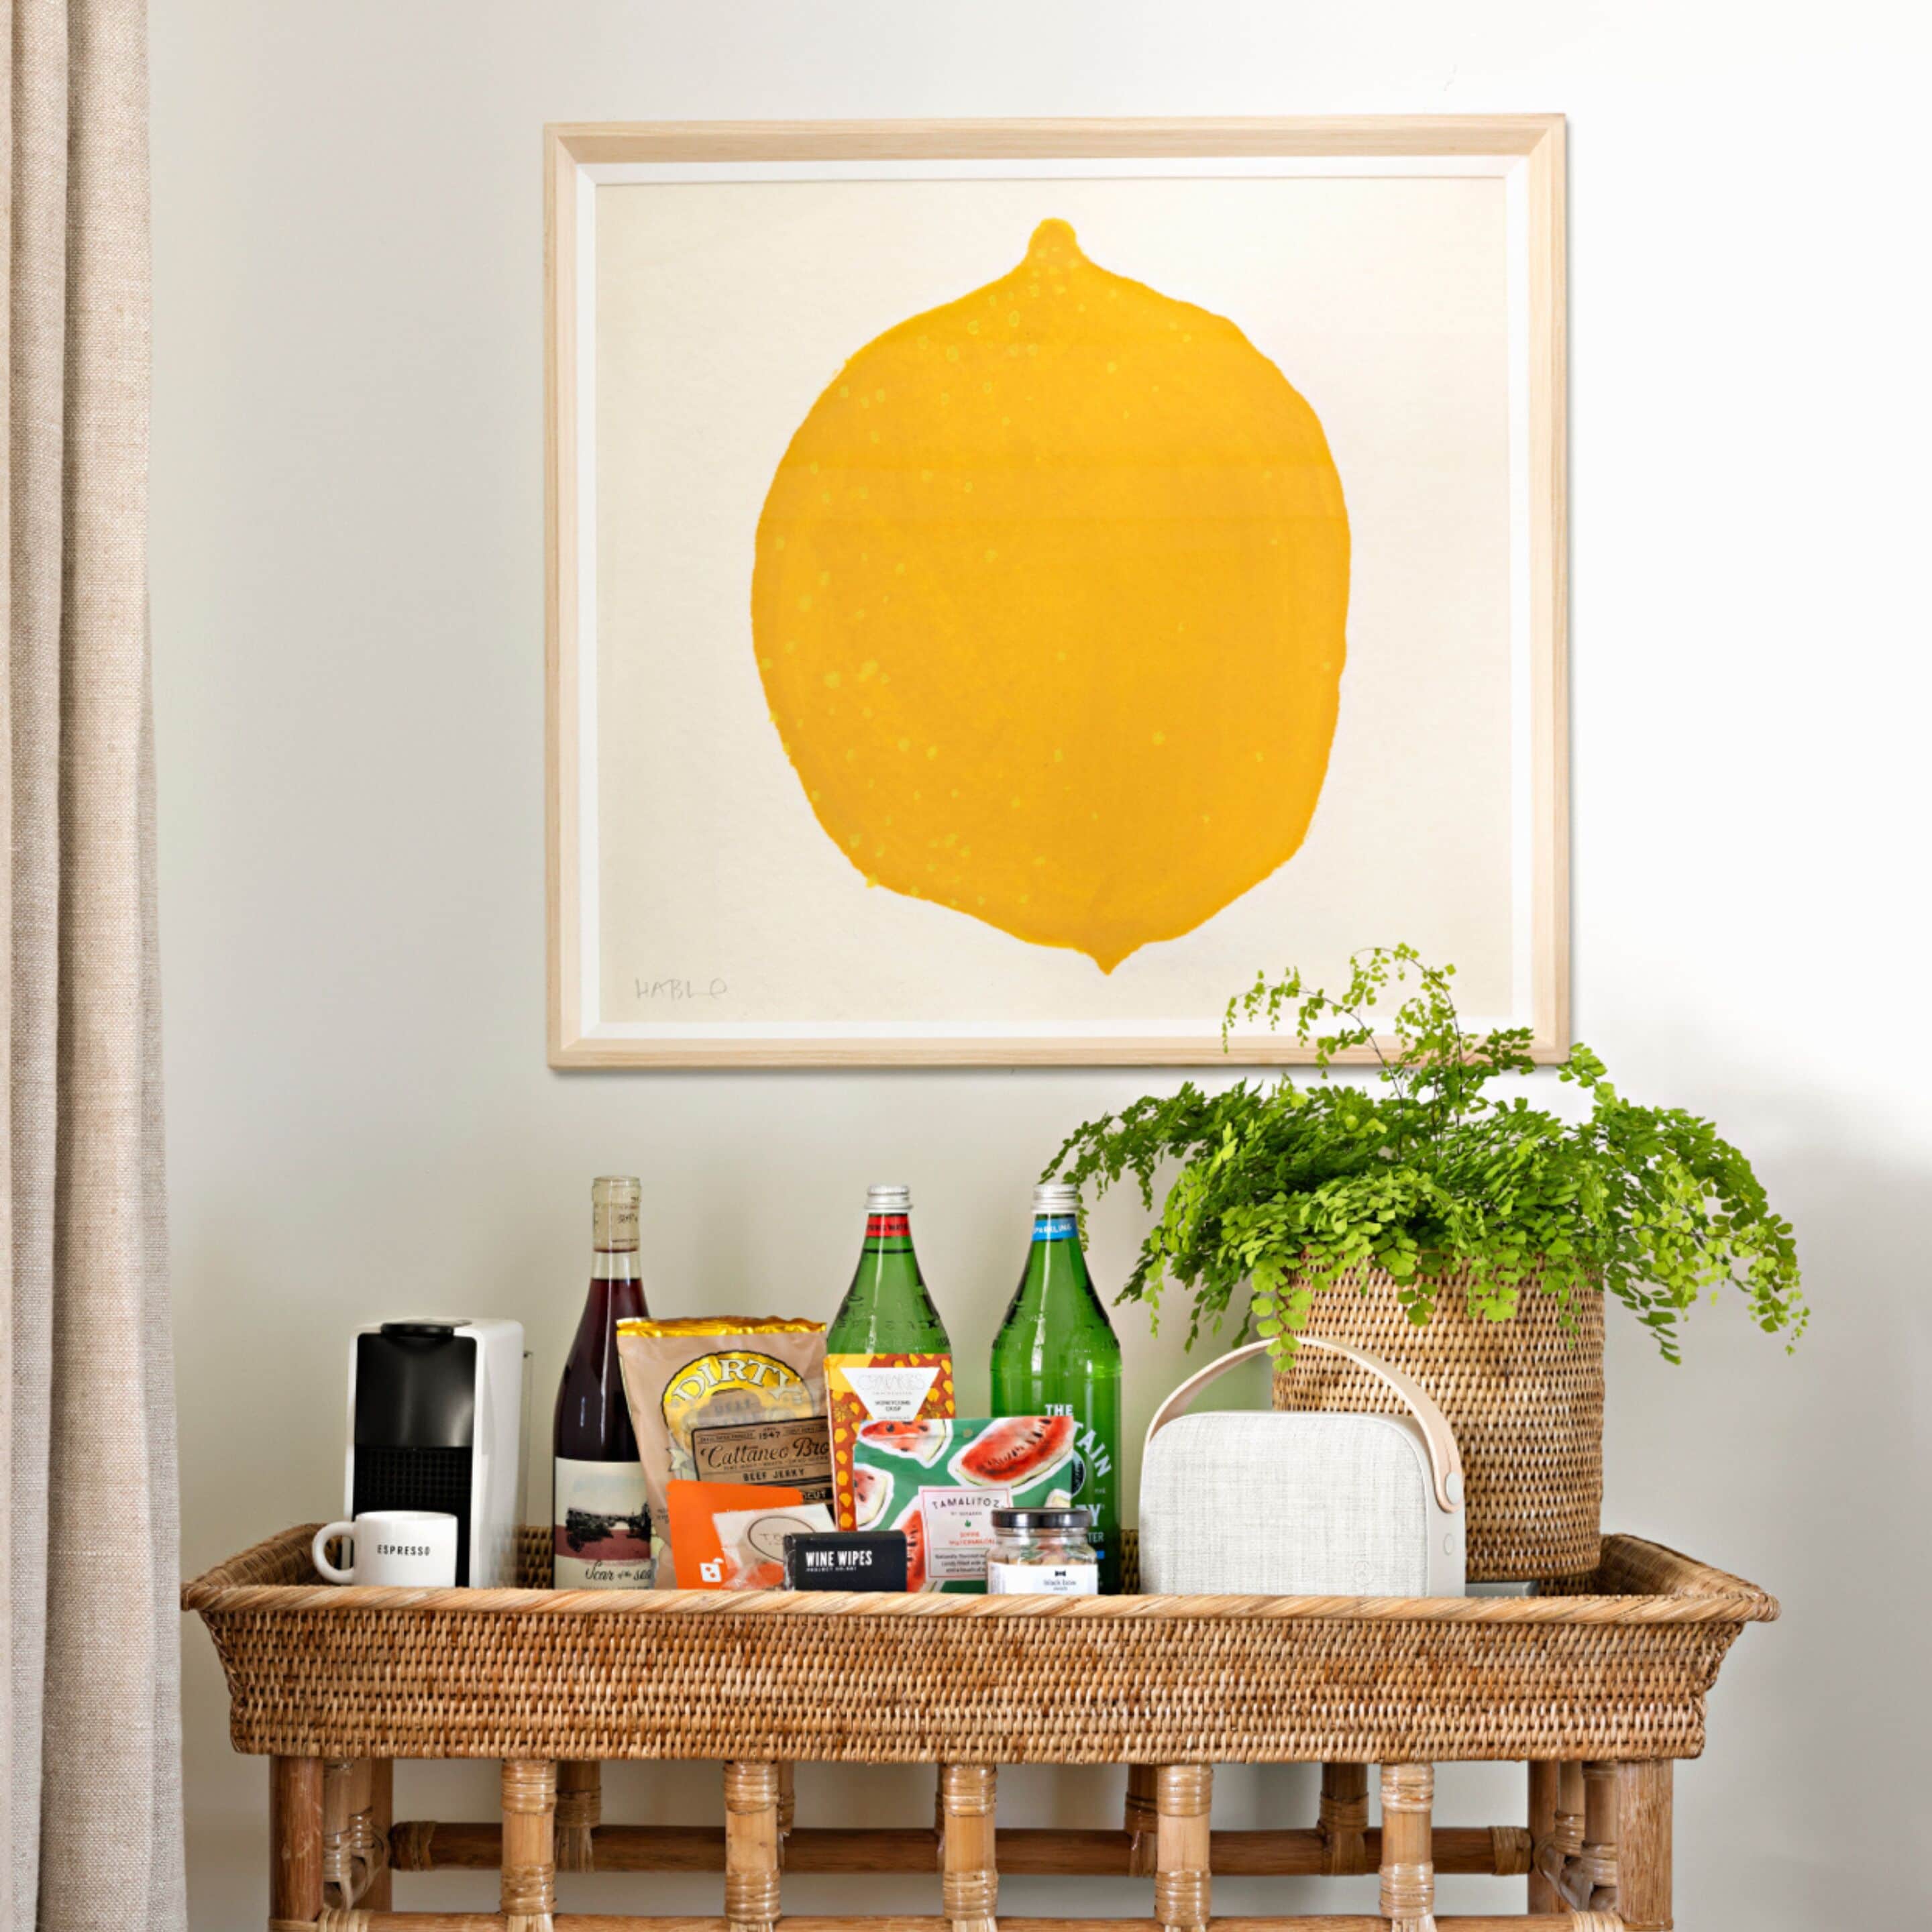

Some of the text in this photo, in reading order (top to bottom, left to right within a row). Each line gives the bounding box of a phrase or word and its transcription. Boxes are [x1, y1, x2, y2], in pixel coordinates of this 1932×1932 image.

[673, 1358, 802, 1401] DIRTY
[1044, 1404, 1074, 1417] THE
[759, 1431, 781, 1440] 1947
[792, 1437, 829, 1458] Bro
[1073, 1420, 1112, 1478] TAIN
[743, 1468, 804, 1482] BEEF JERKY
[1087, 1532, 1104, 1543] TER
[377, 1544, 431, 1556] ESPRESSO
[806, 1550, 873, 1567] WINE WIPES
